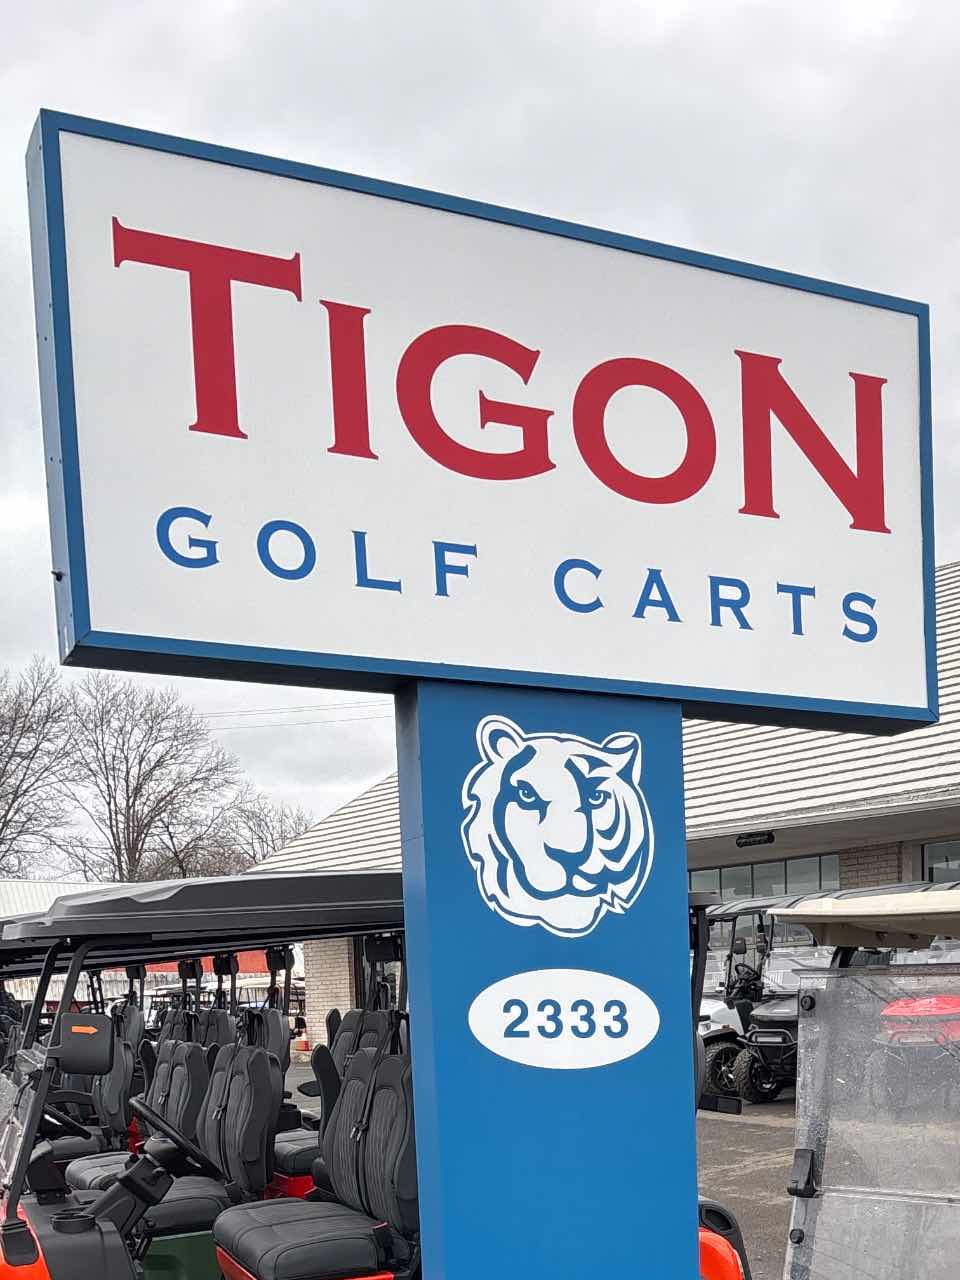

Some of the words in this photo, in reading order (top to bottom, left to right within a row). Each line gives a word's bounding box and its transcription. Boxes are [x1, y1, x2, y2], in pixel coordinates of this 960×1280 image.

[112, 216, 891, 534] TIGON
[156, 506, 477, 597] GOLF
[553, 558, 879, 643] CARTS
[502, 998, 629, 1039] 2333
